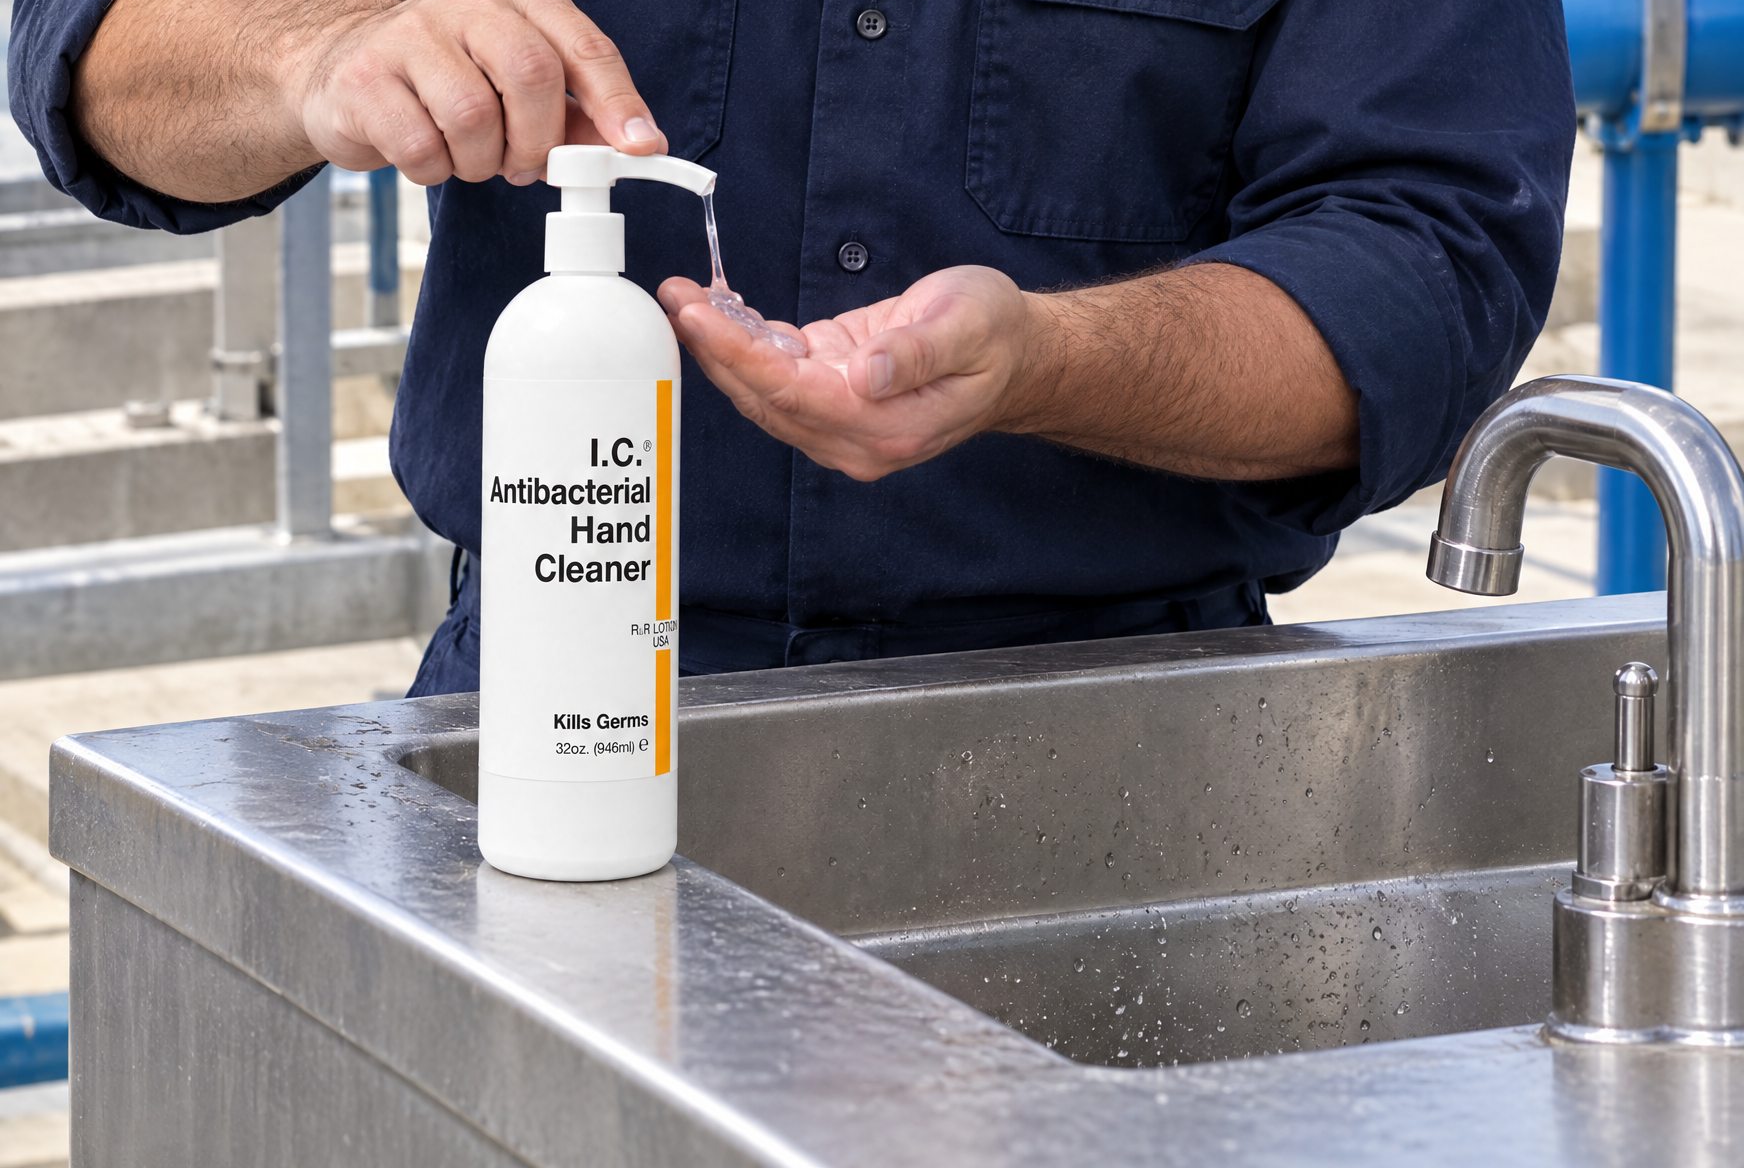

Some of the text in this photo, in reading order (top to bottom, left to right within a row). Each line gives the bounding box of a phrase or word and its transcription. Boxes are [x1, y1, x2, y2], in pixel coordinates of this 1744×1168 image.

[490, 475, 650, 505] Antibacterial
[571, 514, 650, 544] Hand
[535, 553, 651, 583] Cleaner
[652, 635, 669, 648] USA
[554, 713, 649, 730] Kills Germs
[555, 742, 589, 755] 32oz.
[593, 741, 635, 757] (946ml)
